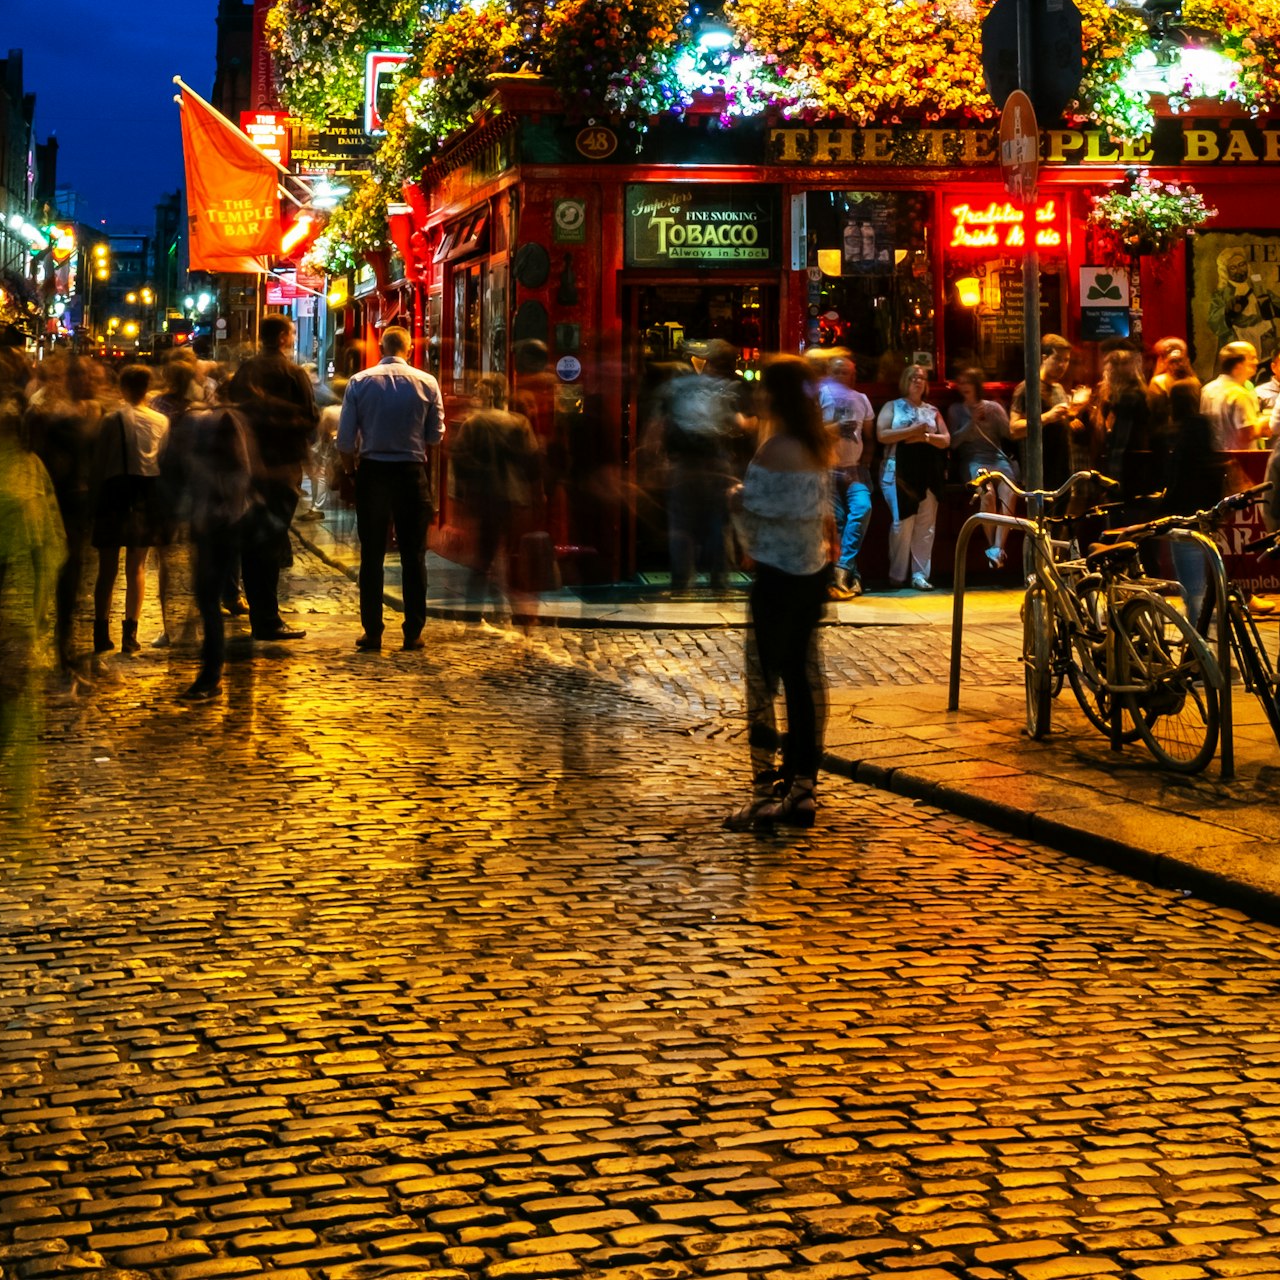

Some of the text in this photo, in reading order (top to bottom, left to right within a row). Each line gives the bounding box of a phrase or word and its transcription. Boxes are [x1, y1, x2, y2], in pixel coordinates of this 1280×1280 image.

[326, 127, 348, 136] LIVE
[338, 137, 366, 145] DAILY
[583, 131, 609, 151] 48
[770, 128, 895, 163] THE
[925, 128, 1156, 163] TEPLE
[223, 199, 254, 210] THE
[631, 191, 693, 217] Importers
[669, 206, 681, 214] OF
[207, 206, 274, 223] TEMPLE
[686, 211, 757, 221] FINE SMOKING
[951, 200, 1056, 225] Traditioal
[224, 223, 259, 236] BAR
[648, 216, 759, 255] TOBACCO
[1005, 224, 1061, 247] Msic
[671, 247, 768, 259] Always in Stock
